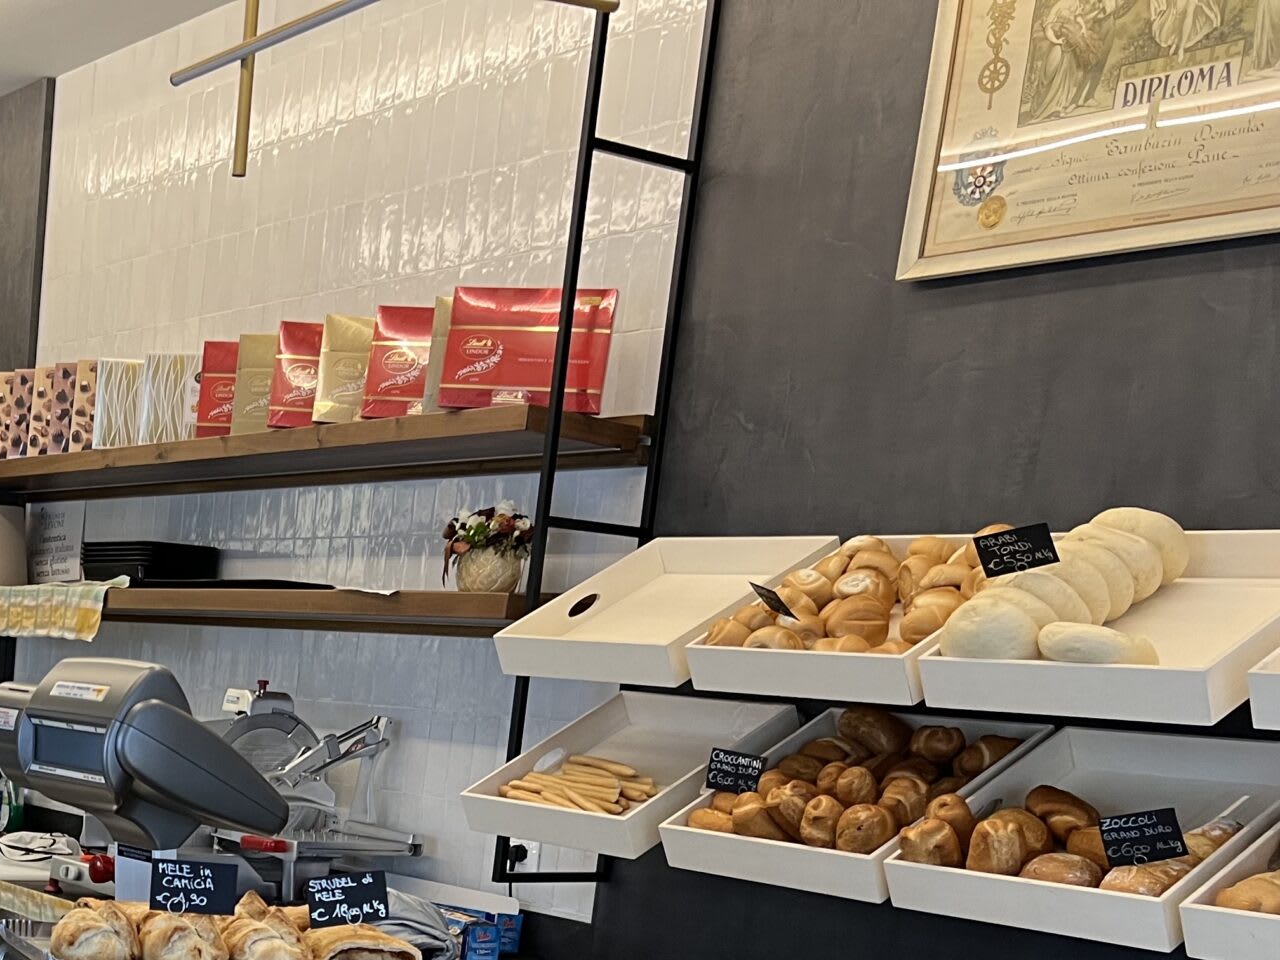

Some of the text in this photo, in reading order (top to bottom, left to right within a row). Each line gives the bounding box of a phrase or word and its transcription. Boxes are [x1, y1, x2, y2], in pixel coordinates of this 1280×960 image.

[1122, 62, 1232, 108] DIPLOMA
[980, 534, 1018, 548] ARABI
[1104, 825, 1173, 840] GRANO DURO
[158, 862, 212, 877] MELE in
[308, 876, 357, 891] STRUDEL
[315, 889, 345, 902] MELE
